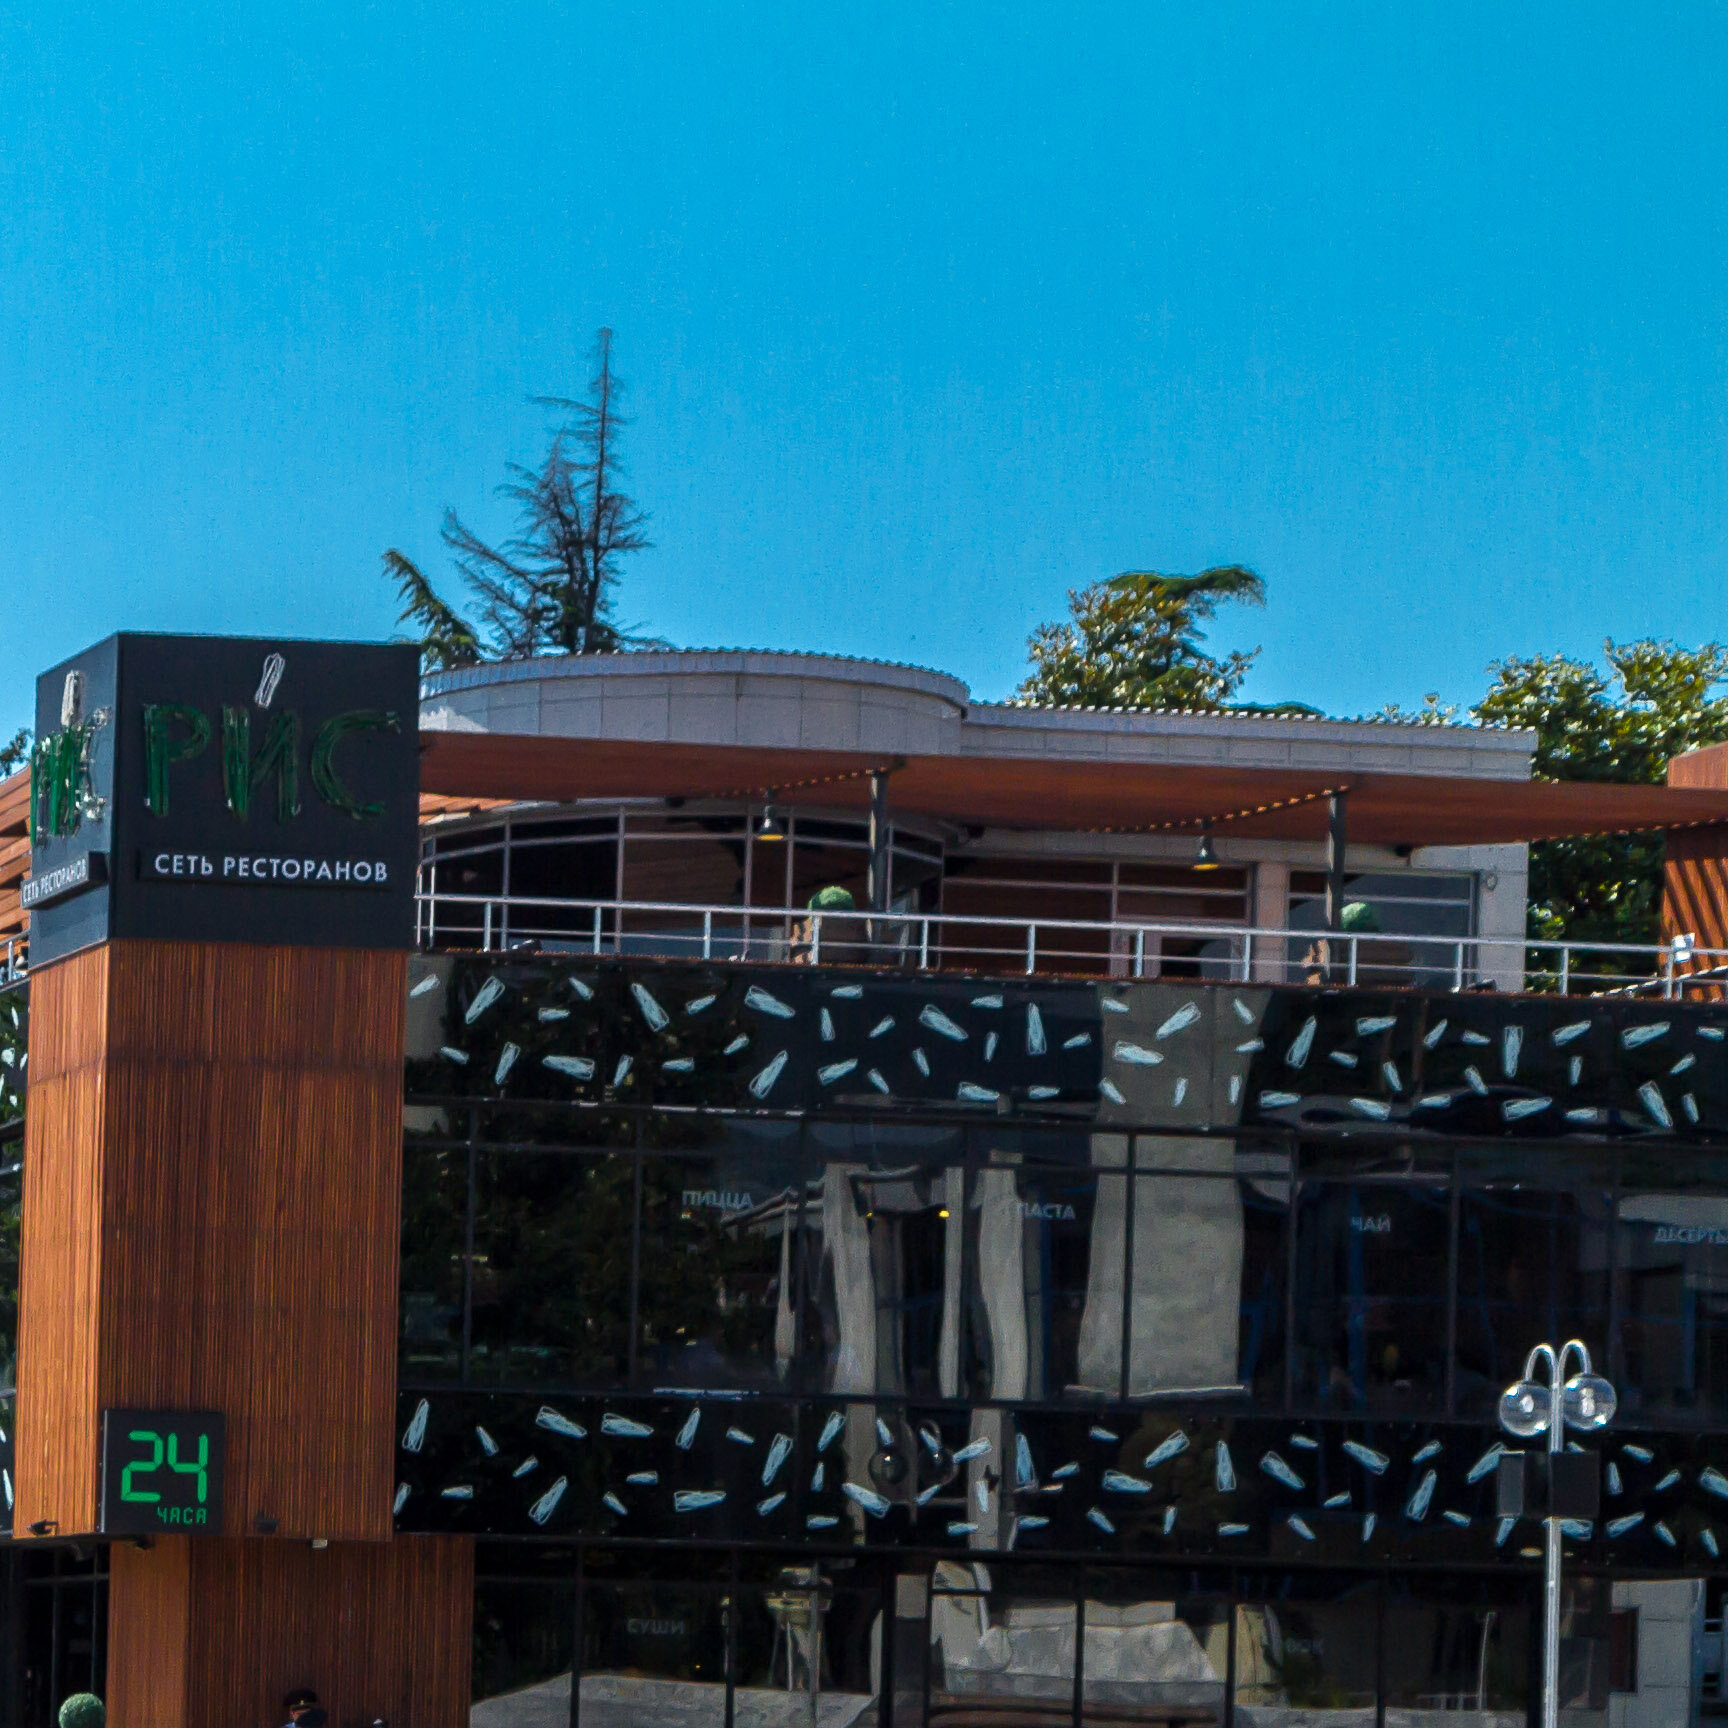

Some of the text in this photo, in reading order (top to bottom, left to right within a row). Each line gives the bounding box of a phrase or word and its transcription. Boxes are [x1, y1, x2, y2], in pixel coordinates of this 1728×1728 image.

[144, 703, 402, 824] РИС
[153, 853, 388, 883] СЕТЬ РЕСТОРАНОВ
[681, 1190, 753, 1210] ПИЦЦА
[1351, 1213, 1391, 1232] ЧАЙ
[121, 1430, 208, 1503] 24
[156, 1506, 207, 1525] ЧАСА
[627, 1618, 685, 1635] СУШИ
